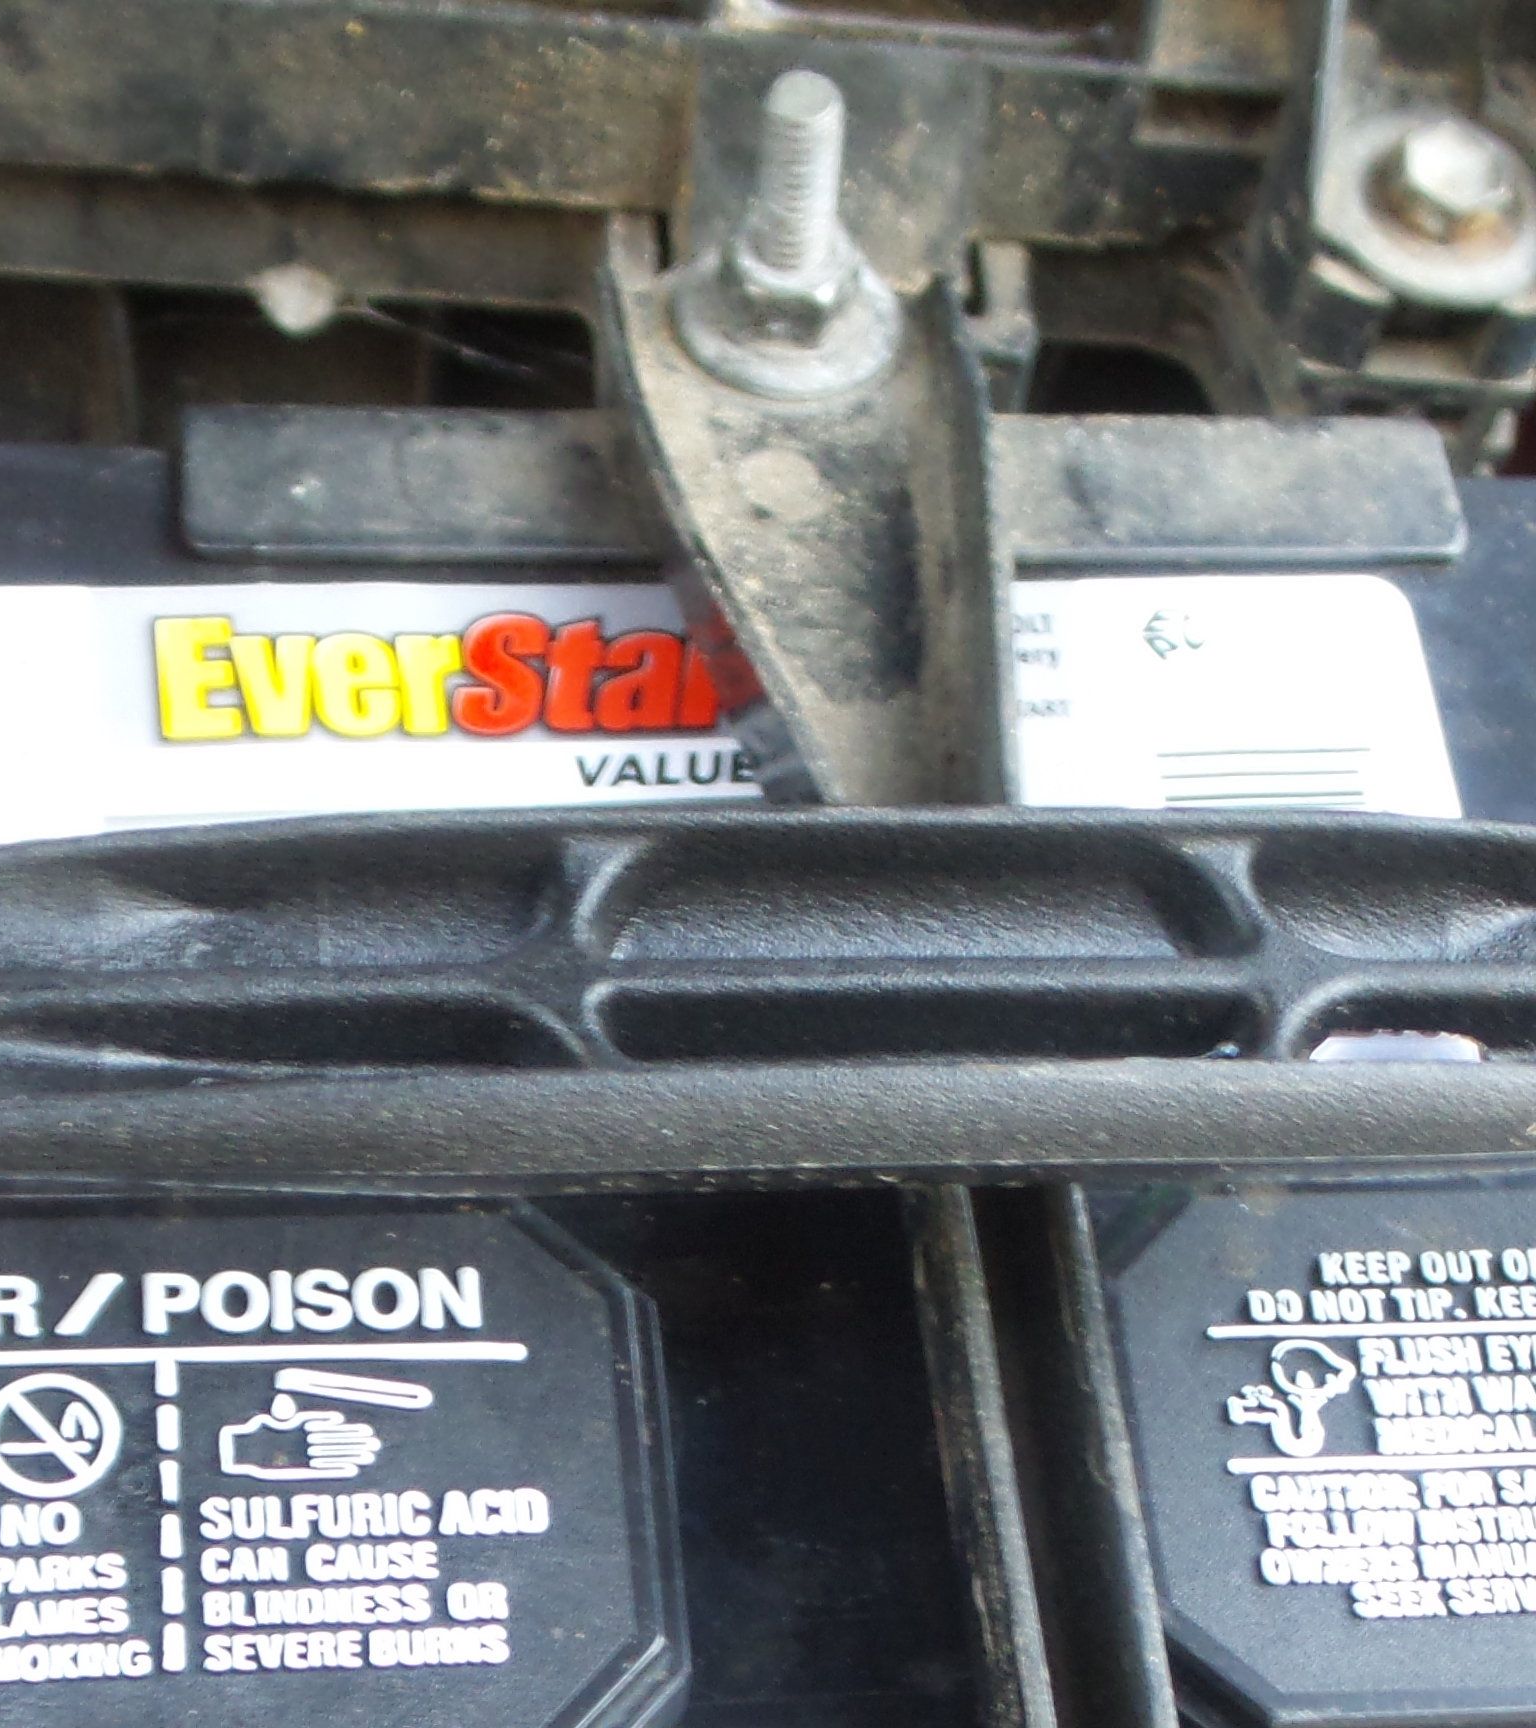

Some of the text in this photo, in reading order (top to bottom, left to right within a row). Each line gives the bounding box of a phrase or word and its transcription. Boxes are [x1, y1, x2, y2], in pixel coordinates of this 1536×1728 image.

[574, 752, 756, 787] VALUE
[1319, 1251, 1411, 1286] KEEP
[1419, 1249, 1492, 1284] OUT
[142, 1266, 483, 1335] POISON
[1247, 1290, 1304, 1323] DO
[1310, 1289, 1385, 1323] NOT
[1391, 1288, 1467, 1321] TIP.
[1358, 1336, 1483, 1377] FLUSH
[1366, 1377, 1473, 1417] WITH
[0, 1501, 81, 1546] NO
[199, 1488, 548, 1542] SULFURIC ACID
[200, 1542, 438, 1585] CAN CAUSE
[201, 1583, 509, 1628] BLINDNESS OR
[203, 1626, 510, 1672] SEVERE BURNS
